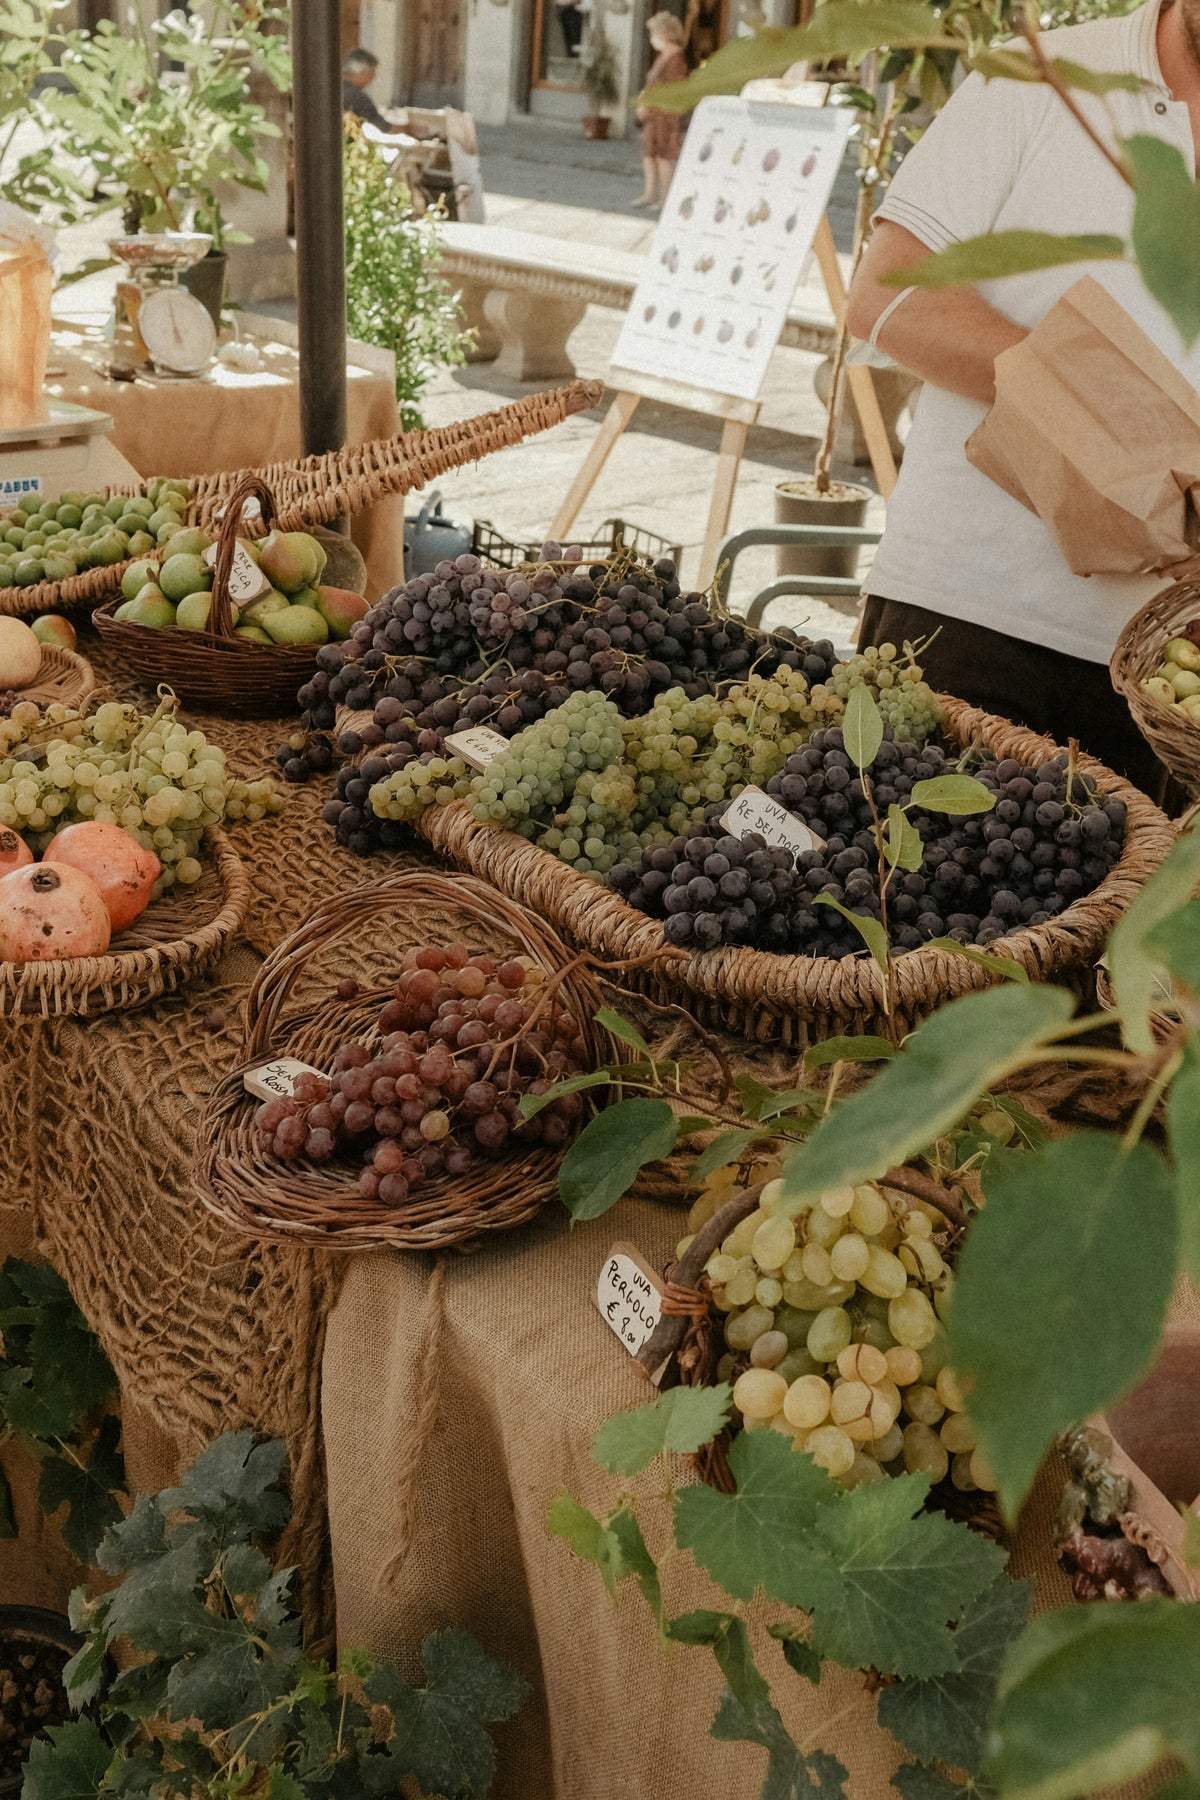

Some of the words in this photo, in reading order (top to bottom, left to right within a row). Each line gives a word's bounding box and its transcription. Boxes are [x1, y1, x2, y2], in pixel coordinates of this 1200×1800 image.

[238, 551, 253, 570] PERE
[736, 800, 753, 819] RE
[755, 817, 773, 835] DEI
[765, 803, 788, 824] UVA
[607, 1260, 657, 1330] PERGOLO
[633, 1272, 652, 1297] UVA
[606, 1301, 620, 1321] €
